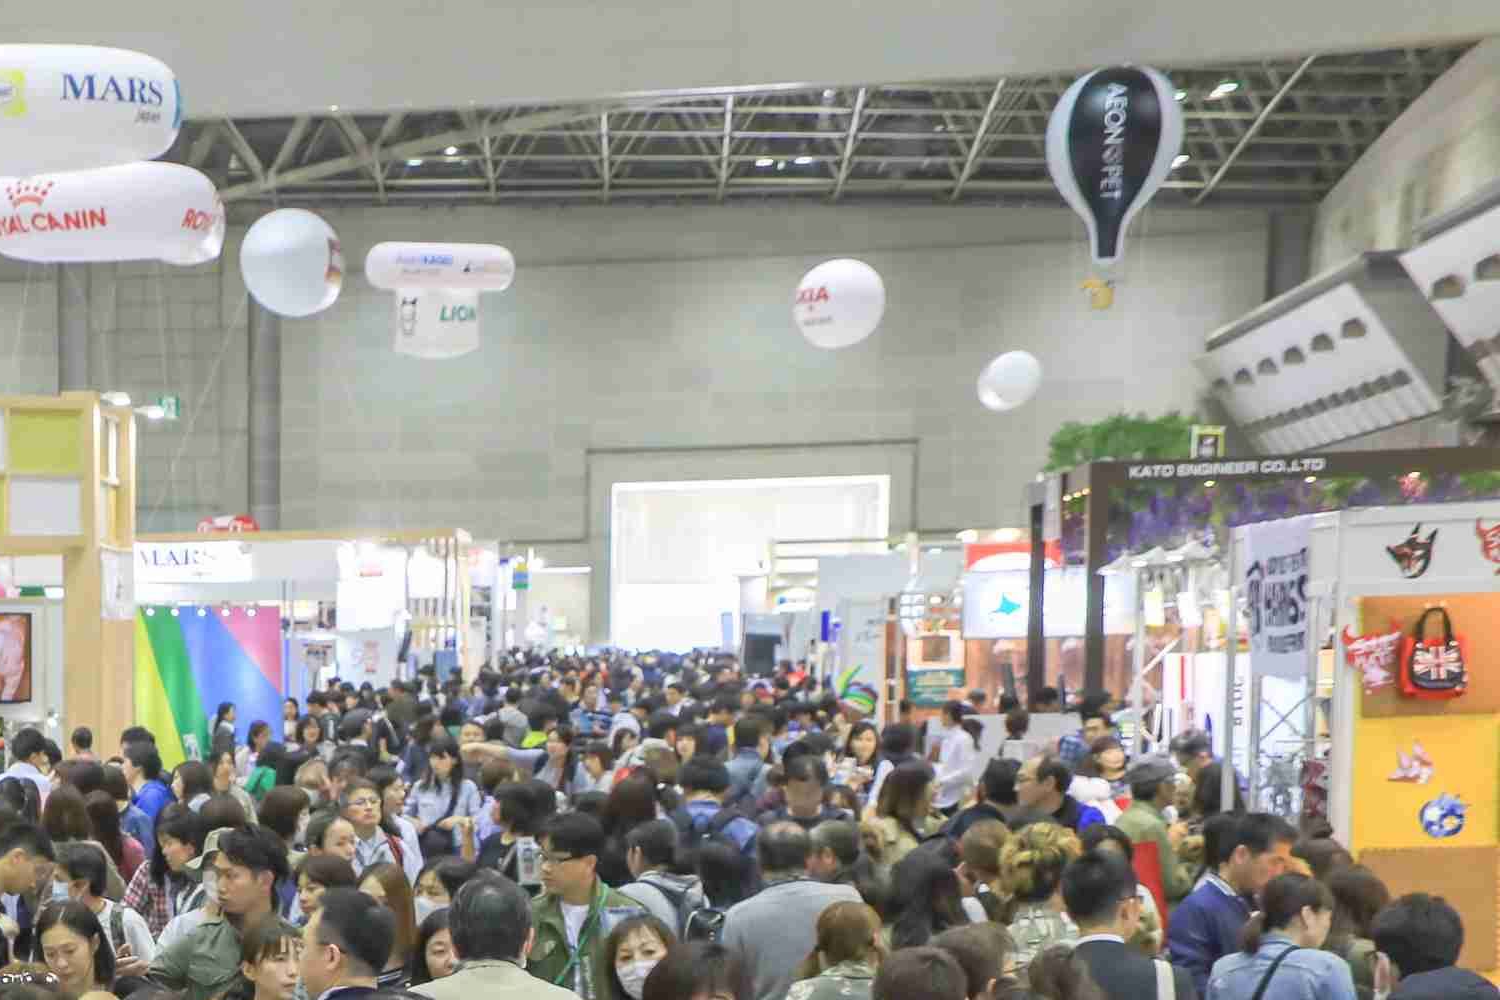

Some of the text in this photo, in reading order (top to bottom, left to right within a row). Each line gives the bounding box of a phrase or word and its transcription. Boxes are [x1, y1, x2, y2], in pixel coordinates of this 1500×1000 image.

[60, 73, 163, 107] MARS
[31, 208, 109, 231] CANIN
[1129, 465, 1175, 479] KATO
[1177, 462, 1258, 477] ENGINEER
